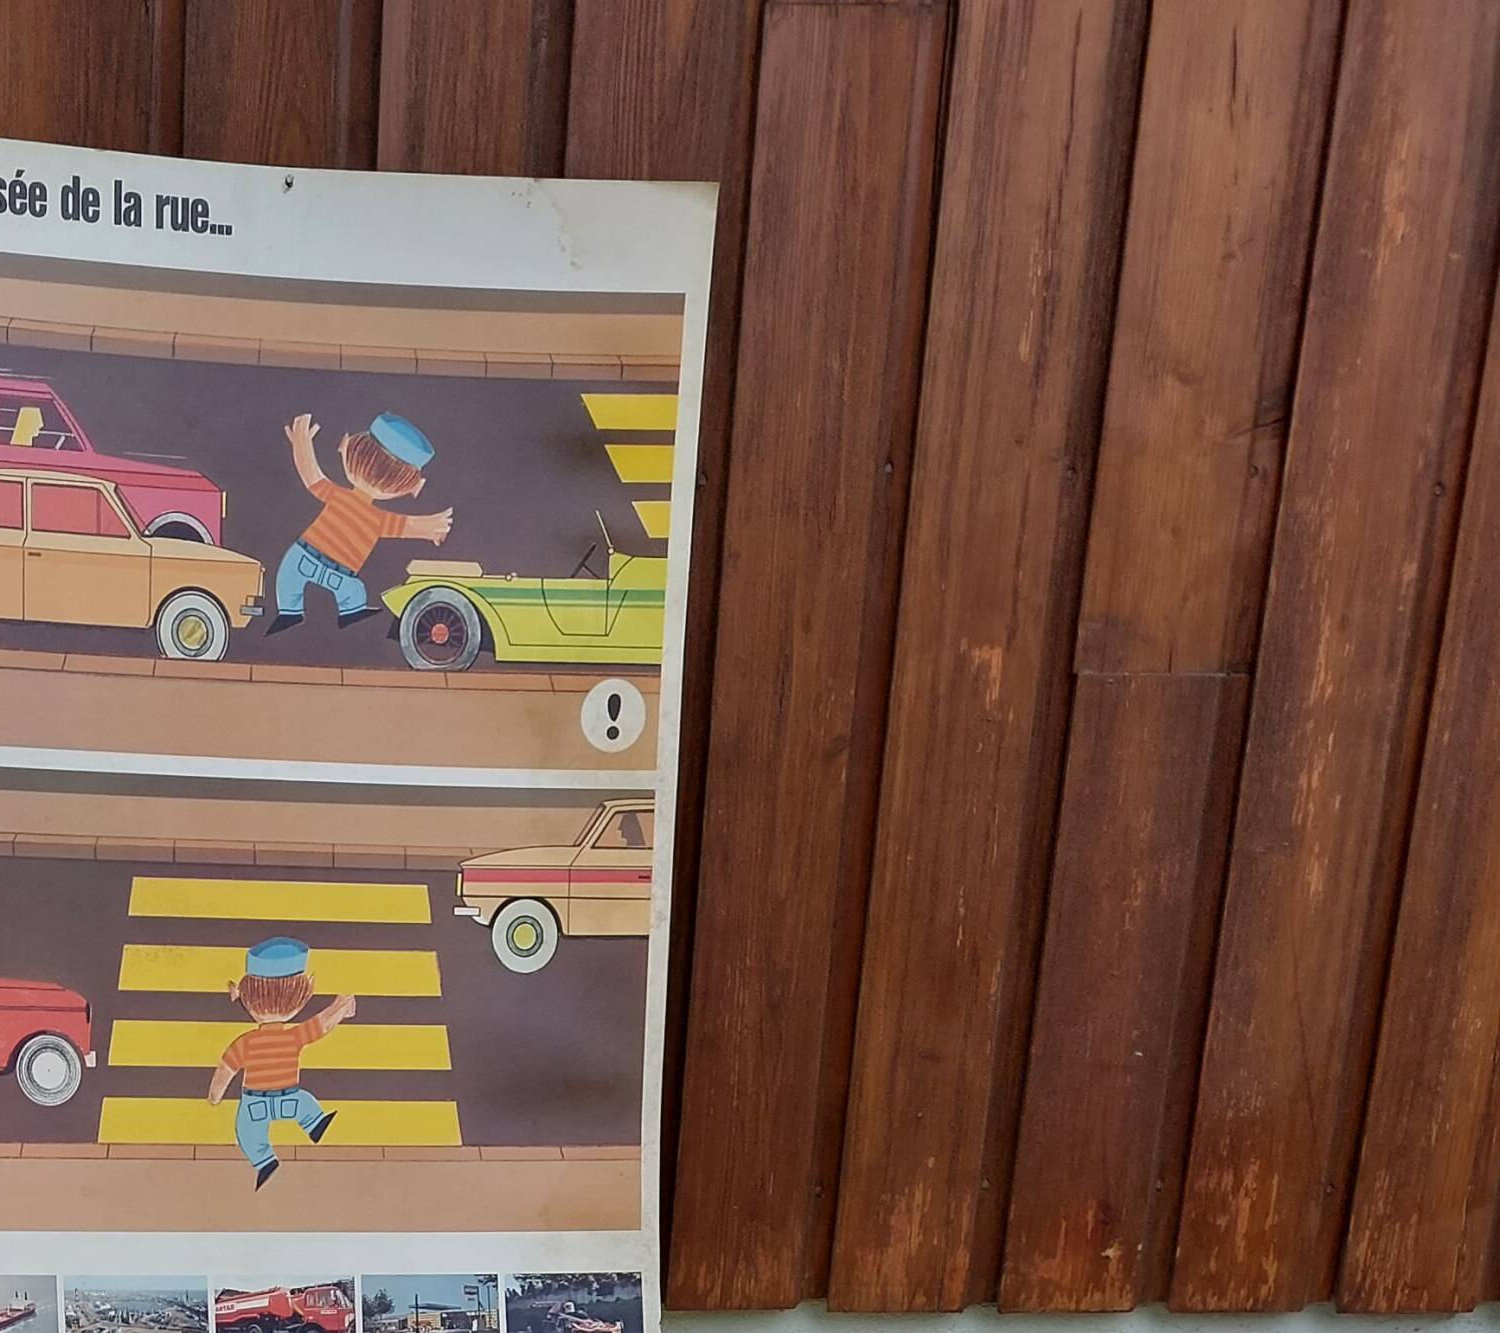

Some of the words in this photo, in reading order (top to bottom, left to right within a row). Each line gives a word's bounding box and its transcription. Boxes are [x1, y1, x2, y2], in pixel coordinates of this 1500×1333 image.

[61, 175, 100, 222] de
[114, 180, 141, 227] la
[155, 194, 233, 235] rue...
